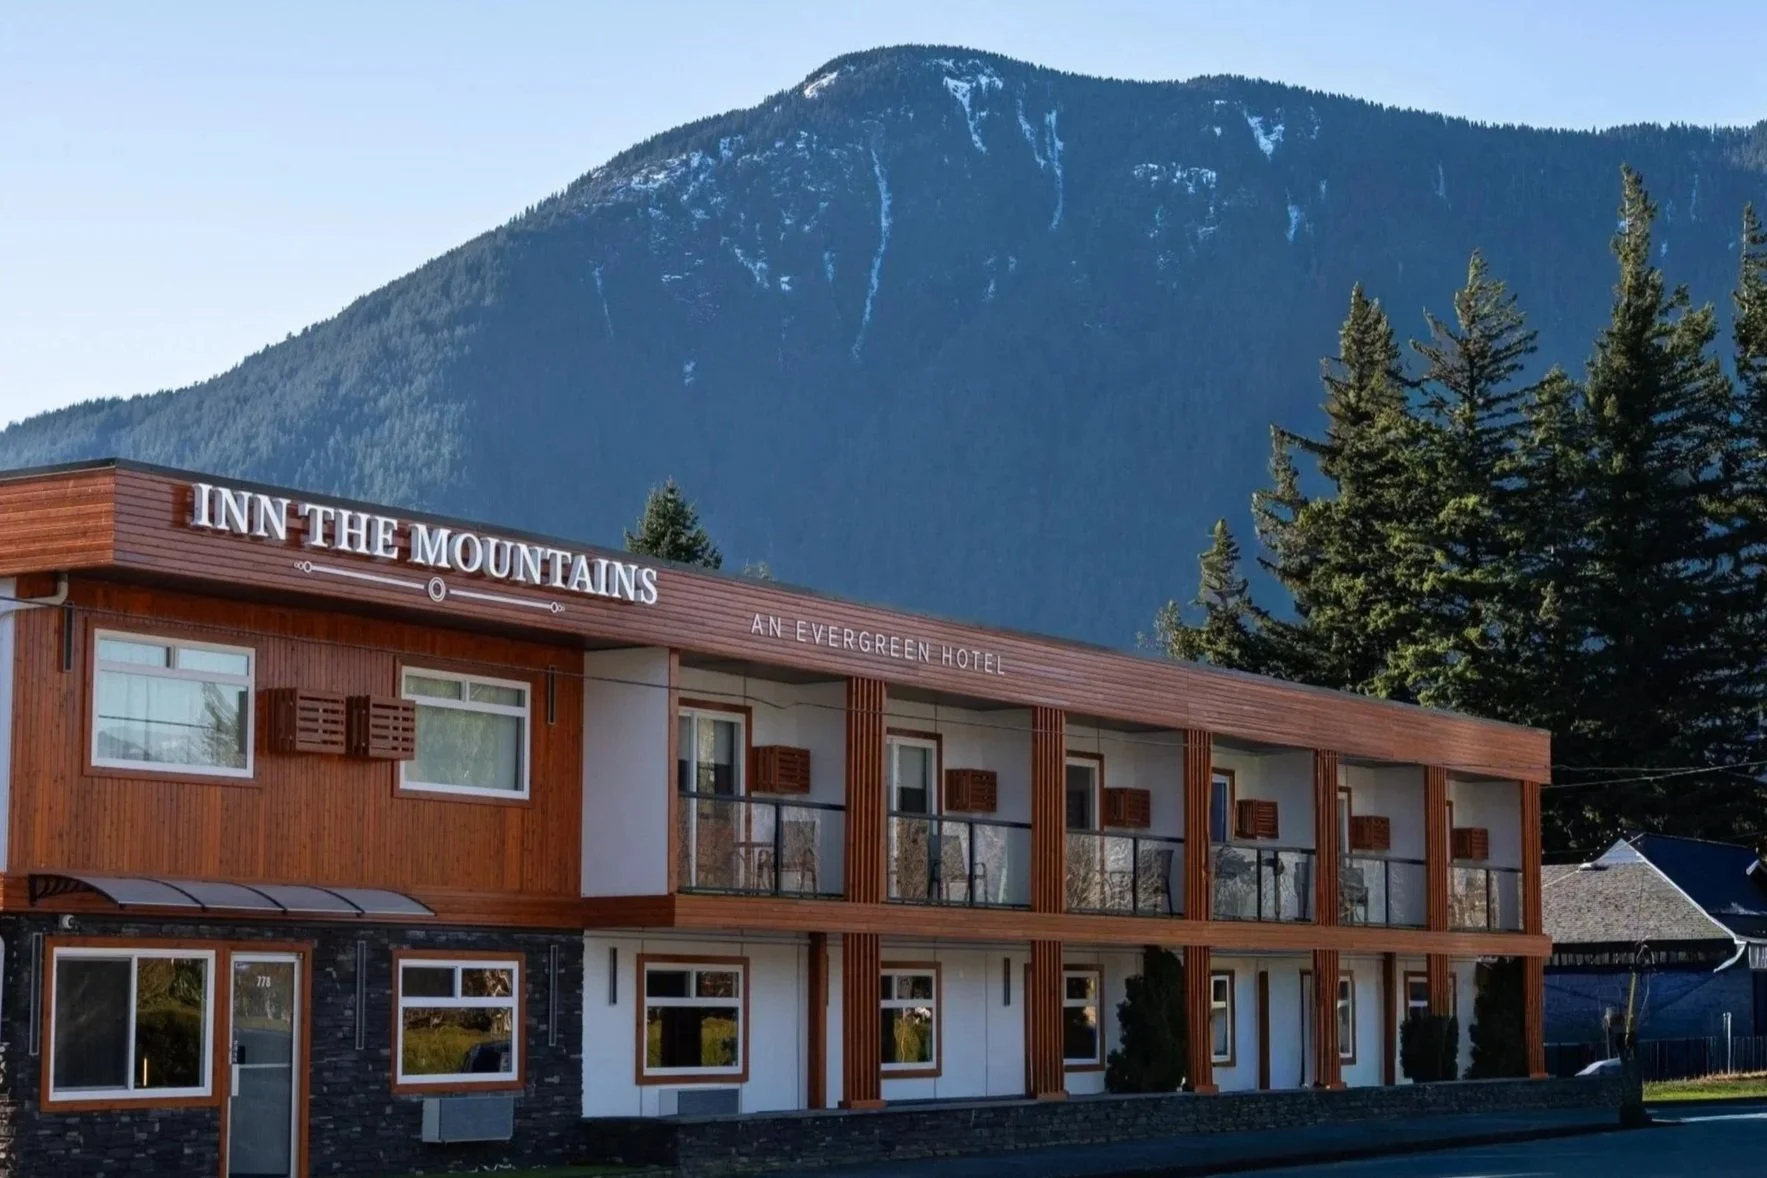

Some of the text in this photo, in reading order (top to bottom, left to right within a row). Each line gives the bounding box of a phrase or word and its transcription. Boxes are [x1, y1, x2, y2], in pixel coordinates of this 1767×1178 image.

[192, 483, 658, 604] INN THE MOUNTAINS
[751, 613, 1005, 675] AN EVERGREEN HOTEL
